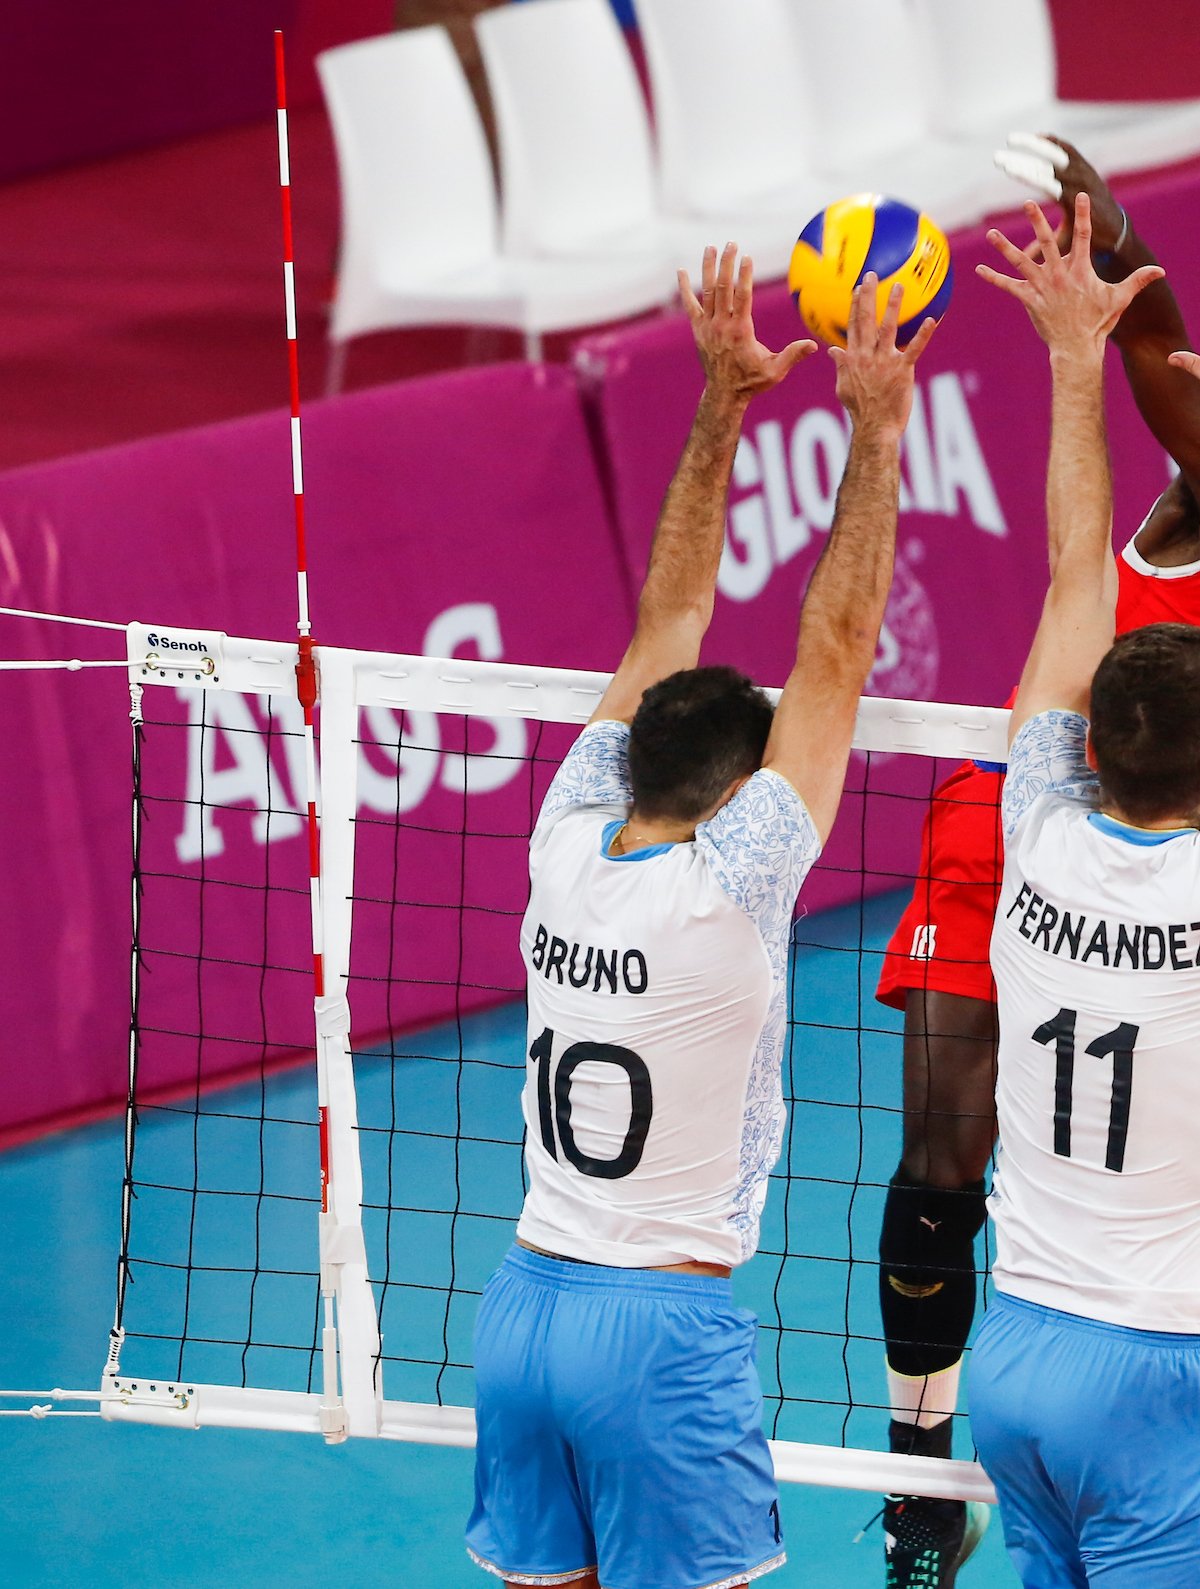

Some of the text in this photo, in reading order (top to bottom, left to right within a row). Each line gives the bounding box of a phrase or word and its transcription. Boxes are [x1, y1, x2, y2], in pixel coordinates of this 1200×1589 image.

[716, 371, 1008, 601] GLOIA
[160, 637, 208, 652] Senoh
[532, 923, 648, 994] BRUNO
[909, 924, 938, 961] 18
[529, 1027, 652, 1179] 10
[1031, 1007, 1140, 1173] 11
